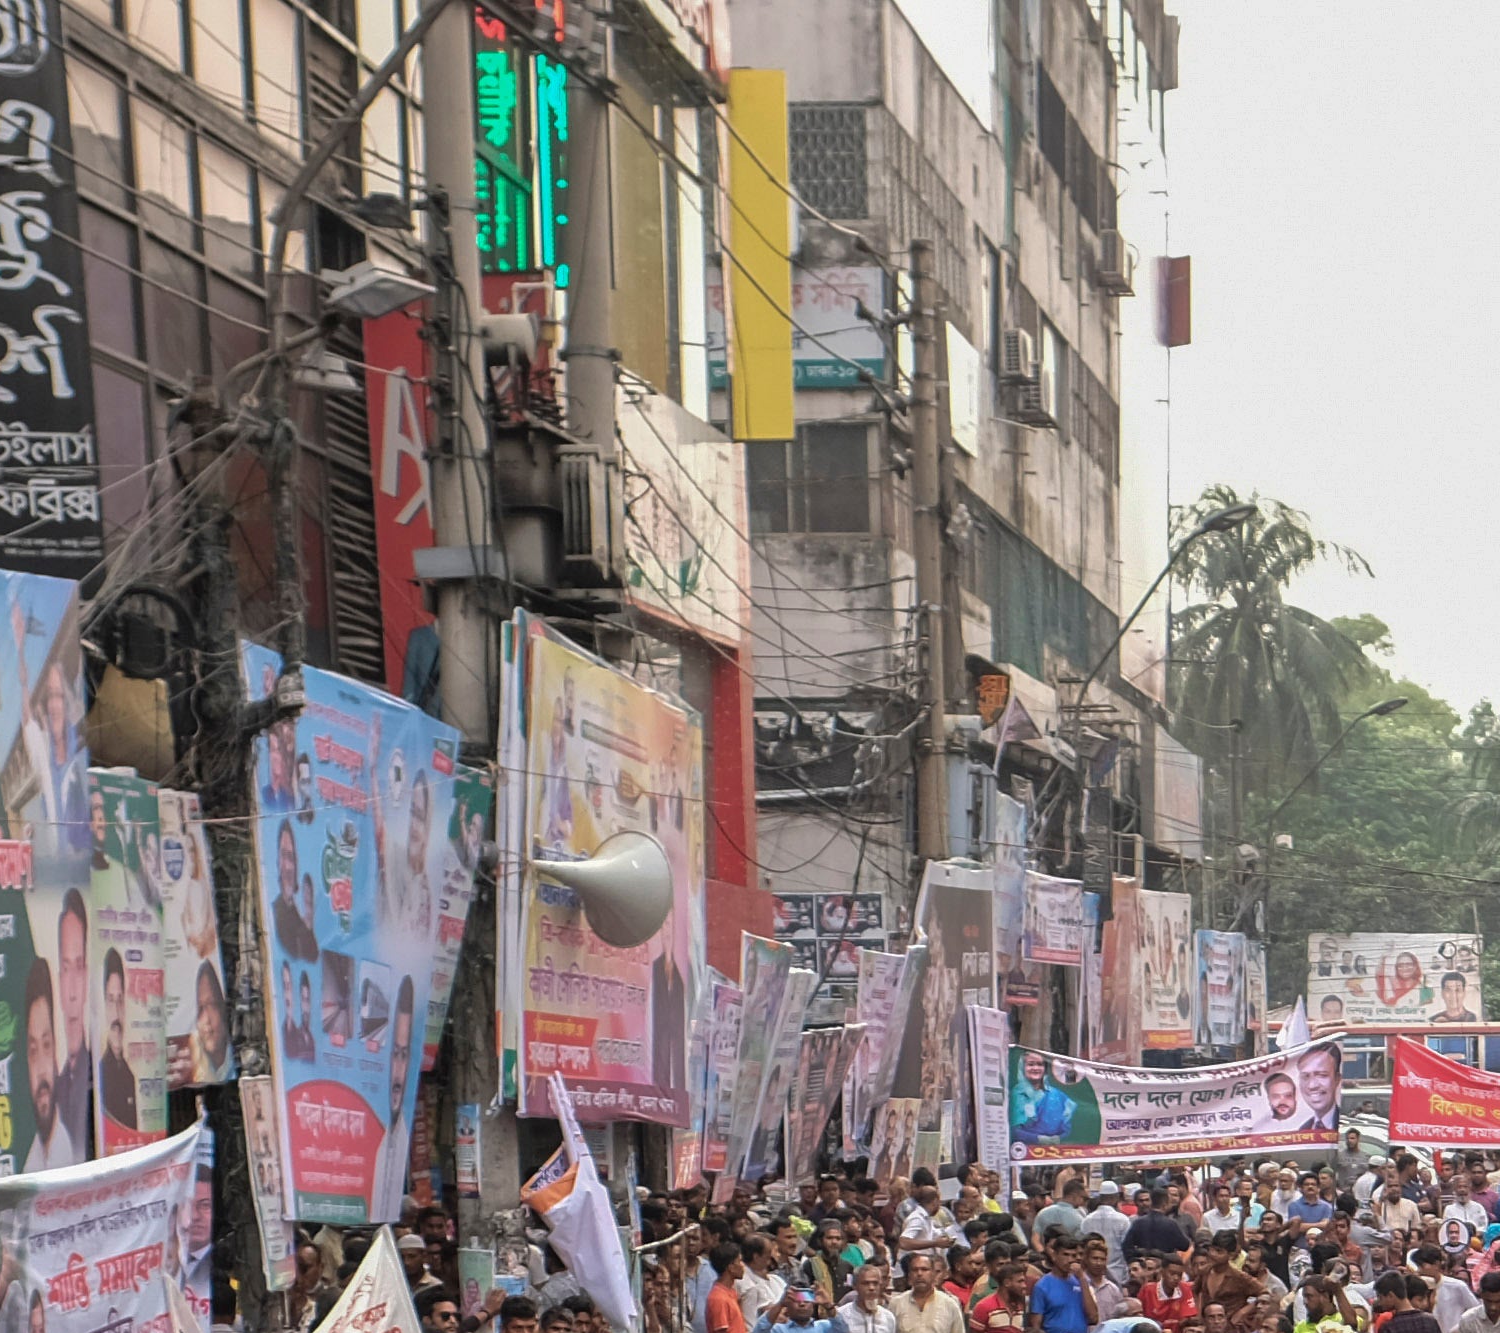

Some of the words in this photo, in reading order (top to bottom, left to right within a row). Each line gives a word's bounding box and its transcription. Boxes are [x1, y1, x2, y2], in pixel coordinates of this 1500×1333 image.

[1102, 1089, 1140, 1110] দলে
[1146, 1087, 1183, 1108] দলে
[1188, 1088, 1226, 1107] যোগ
[1228, 1079, 1264, 1100] দিন
[1429, 1094, 1487, 1119] বিক্ষোভ
[1394, 1121, 1466, 1138] বাংলাদেশের
[46, 1252, 91, 1313] শান্তি
[94, 1241, 165, 1297] সমাবেশ
